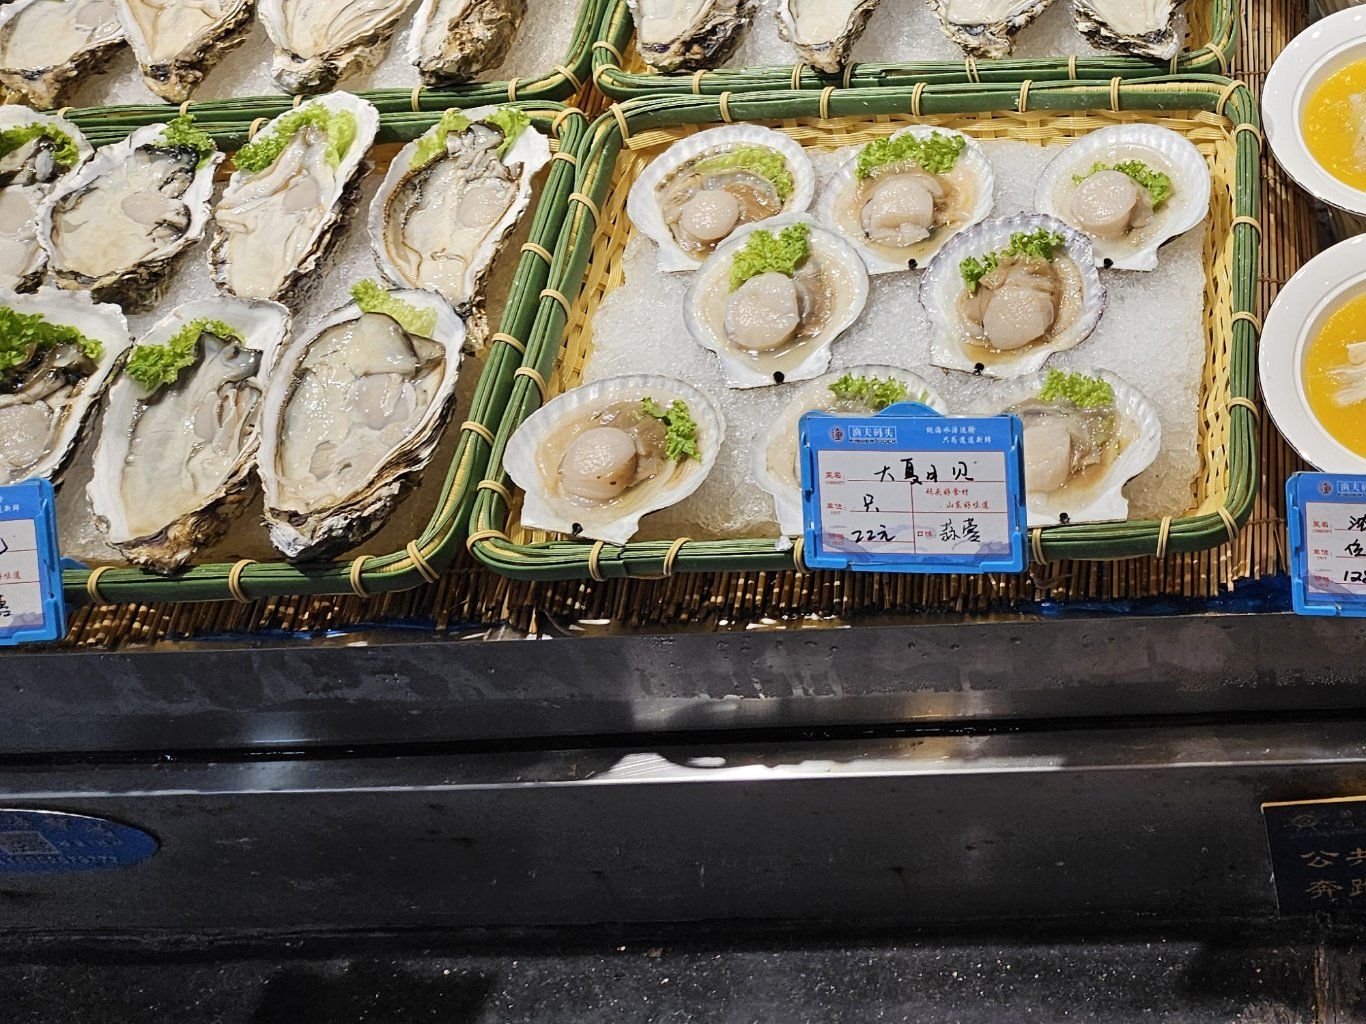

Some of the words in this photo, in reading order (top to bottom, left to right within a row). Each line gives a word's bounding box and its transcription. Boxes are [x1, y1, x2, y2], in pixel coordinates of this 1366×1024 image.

[851, 427, 894, 438] 渔夫码头
[864, 494, 880, 512] 只
[946, 501, 989, 510] 山东好味道
[852, 525, 896, 542] 22元
[939, 518, 980, 542] 蒜蓉
[1345, 539, 1366, 557] 位
[0, 570, 20, 580] 味道
